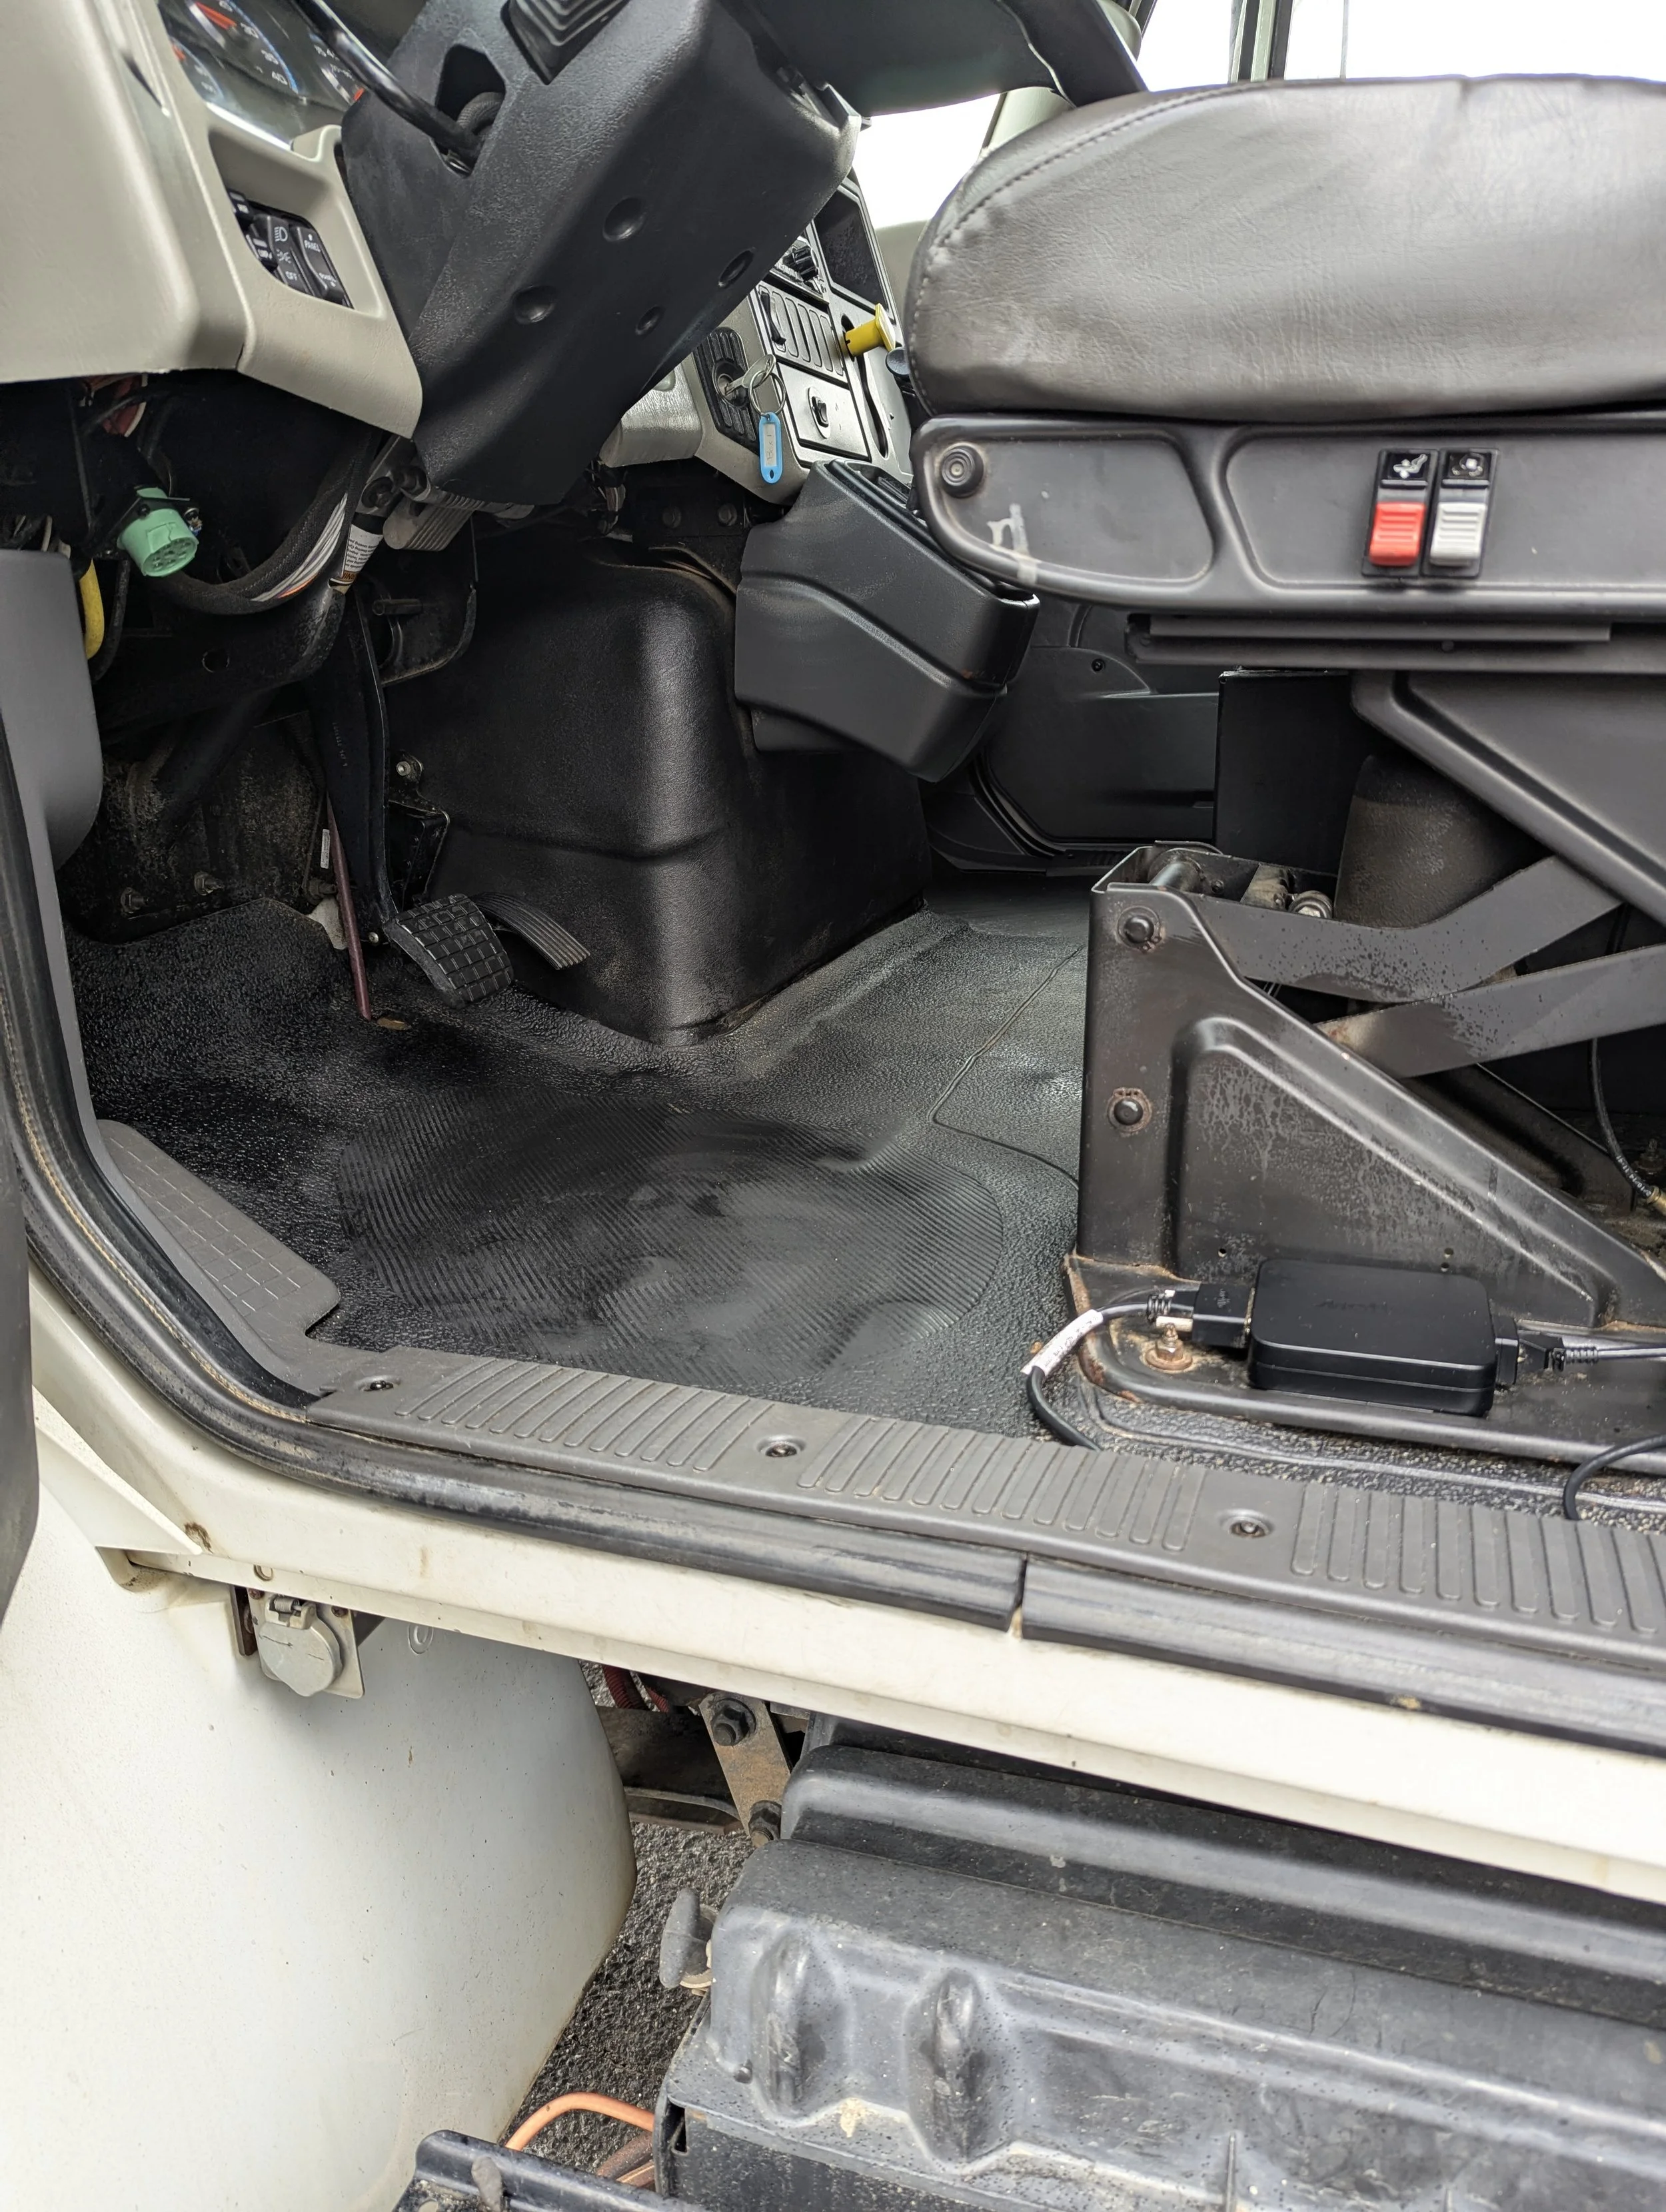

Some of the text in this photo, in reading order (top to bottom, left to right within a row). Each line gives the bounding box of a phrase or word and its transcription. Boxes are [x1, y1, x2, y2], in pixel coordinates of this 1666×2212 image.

[240, 22, 259, 39] 30
[271, 70, 288, 85] 40
[304, 239, 321, 253] PANEL
[285, 271, 298, 280] OFF
